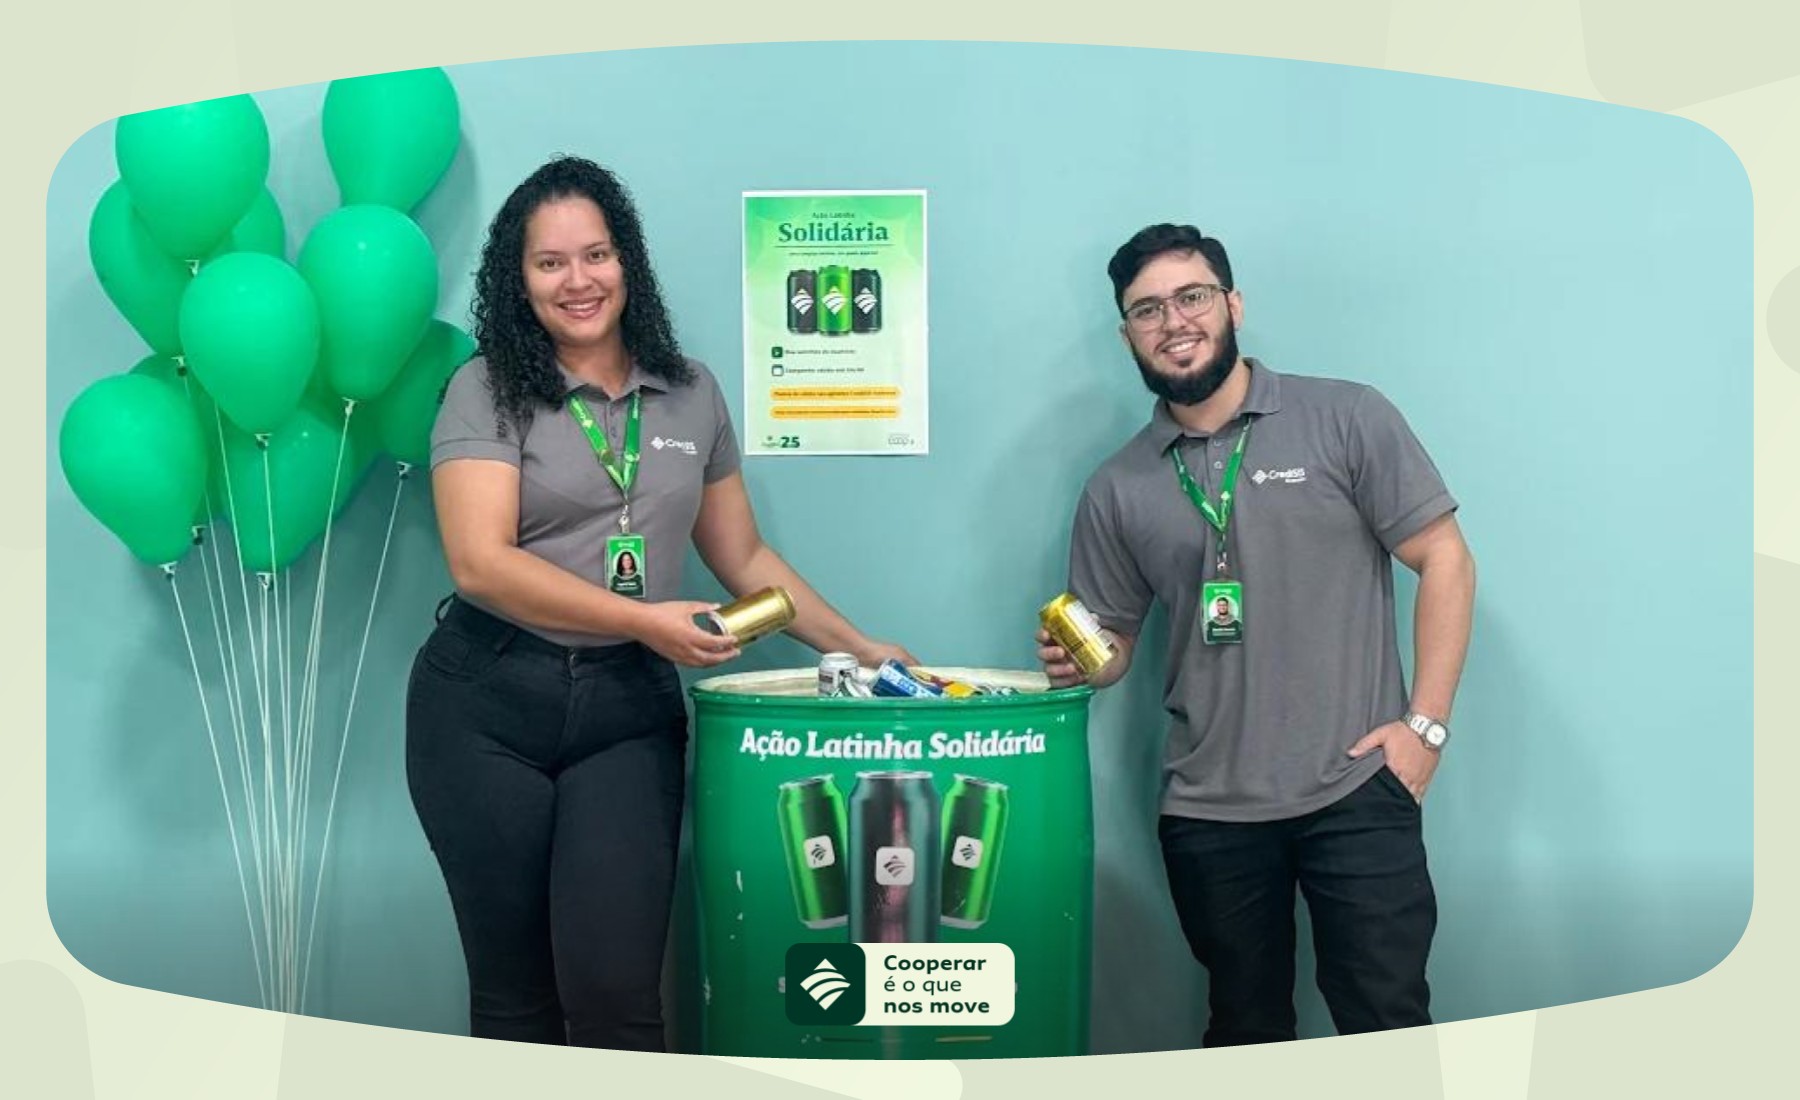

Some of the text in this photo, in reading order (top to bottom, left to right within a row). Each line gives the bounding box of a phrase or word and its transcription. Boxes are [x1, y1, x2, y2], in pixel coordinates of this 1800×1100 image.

[778, 222, 889, 243] Solidária
[780, 436, 800, 448] 25
[740, 728, 1046, 761] Ação Latinha Solidária
